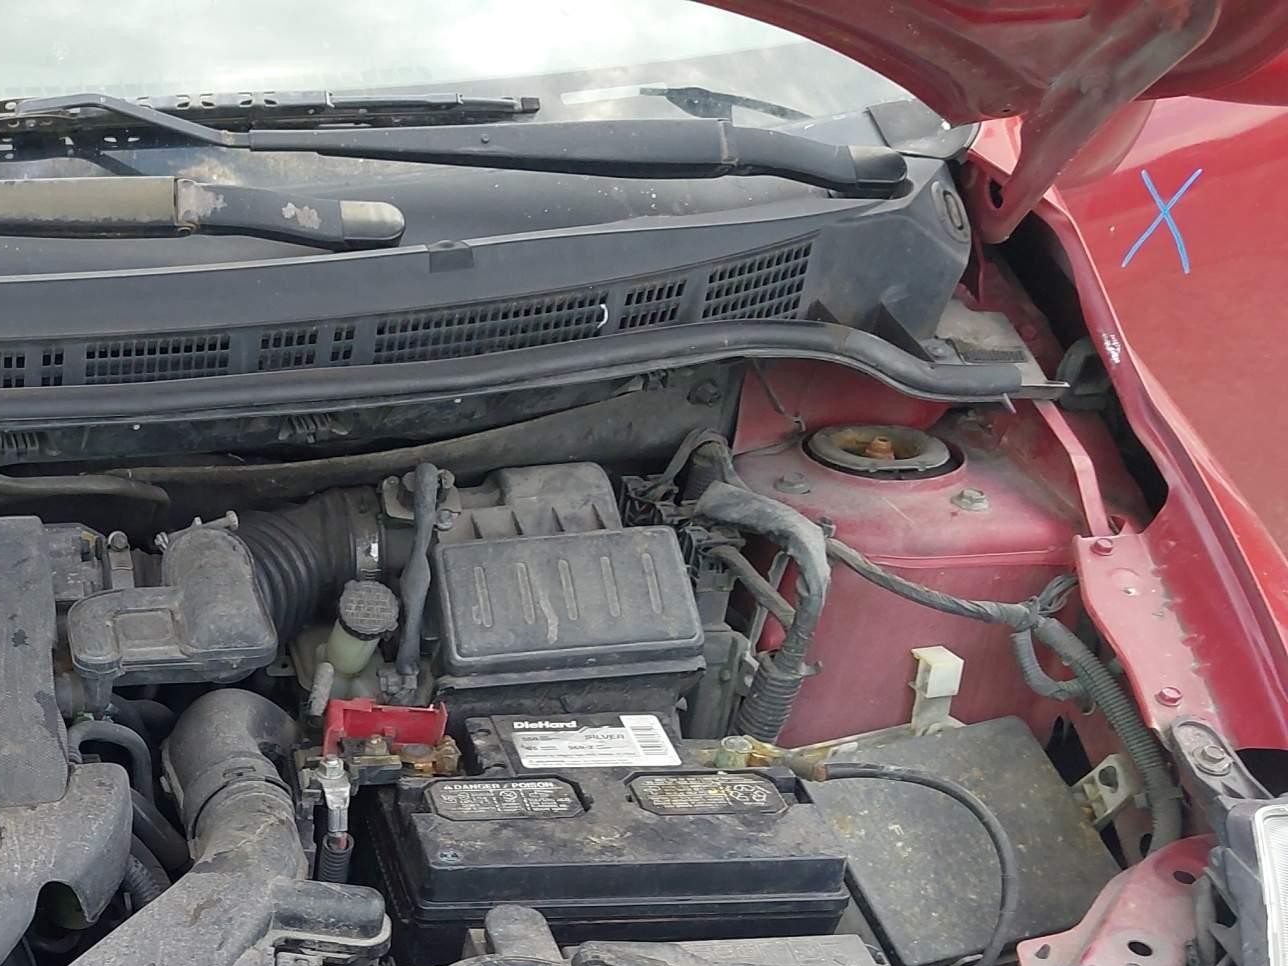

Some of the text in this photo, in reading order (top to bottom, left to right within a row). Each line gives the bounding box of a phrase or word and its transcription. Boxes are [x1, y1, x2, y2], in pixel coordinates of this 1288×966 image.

[1121, 168, 1204, 275] X
[513, 720, 578, 729] DieHard
[511, 781, 554, 789] POISON
